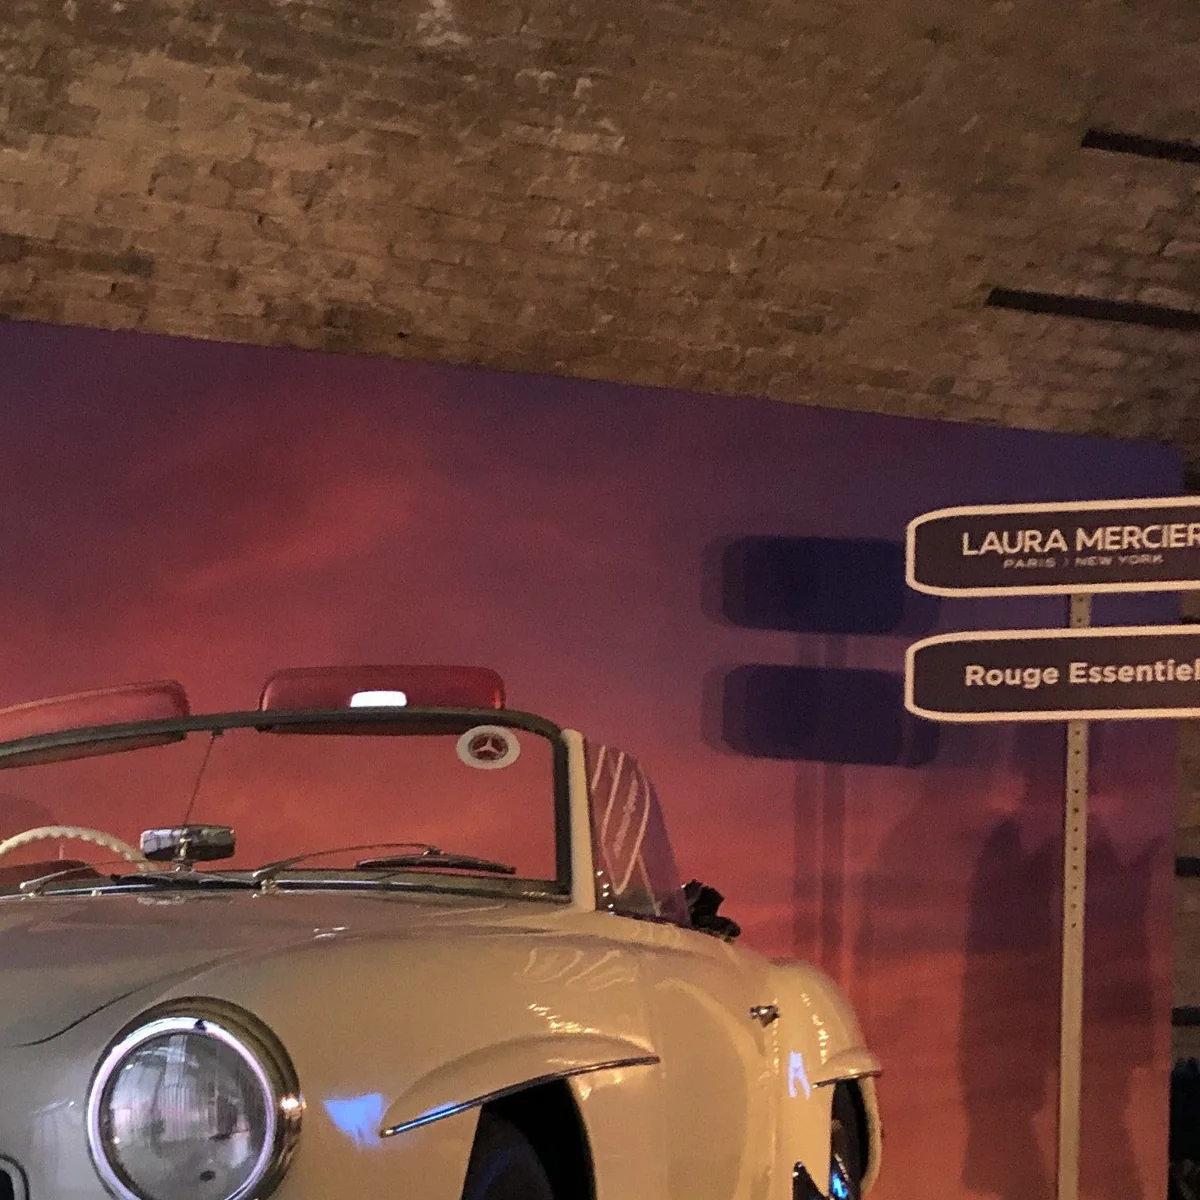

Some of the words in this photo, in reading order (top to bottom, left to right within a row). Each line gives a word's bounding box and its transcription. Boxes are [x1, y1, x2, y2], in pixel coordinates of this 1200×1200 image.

[962, 529, 1068, 556] LAURA
[1075, 523, 1200, 551] MERCIER
[1003, 556, 1056, 569] PARIS
[1075, 555, 1113, 567] NEW
[1118, 553, 1164, 566] YORK
[964, 664, 1060, 690] Rouge
[1069, 657, 1200, 684] Essentiel
